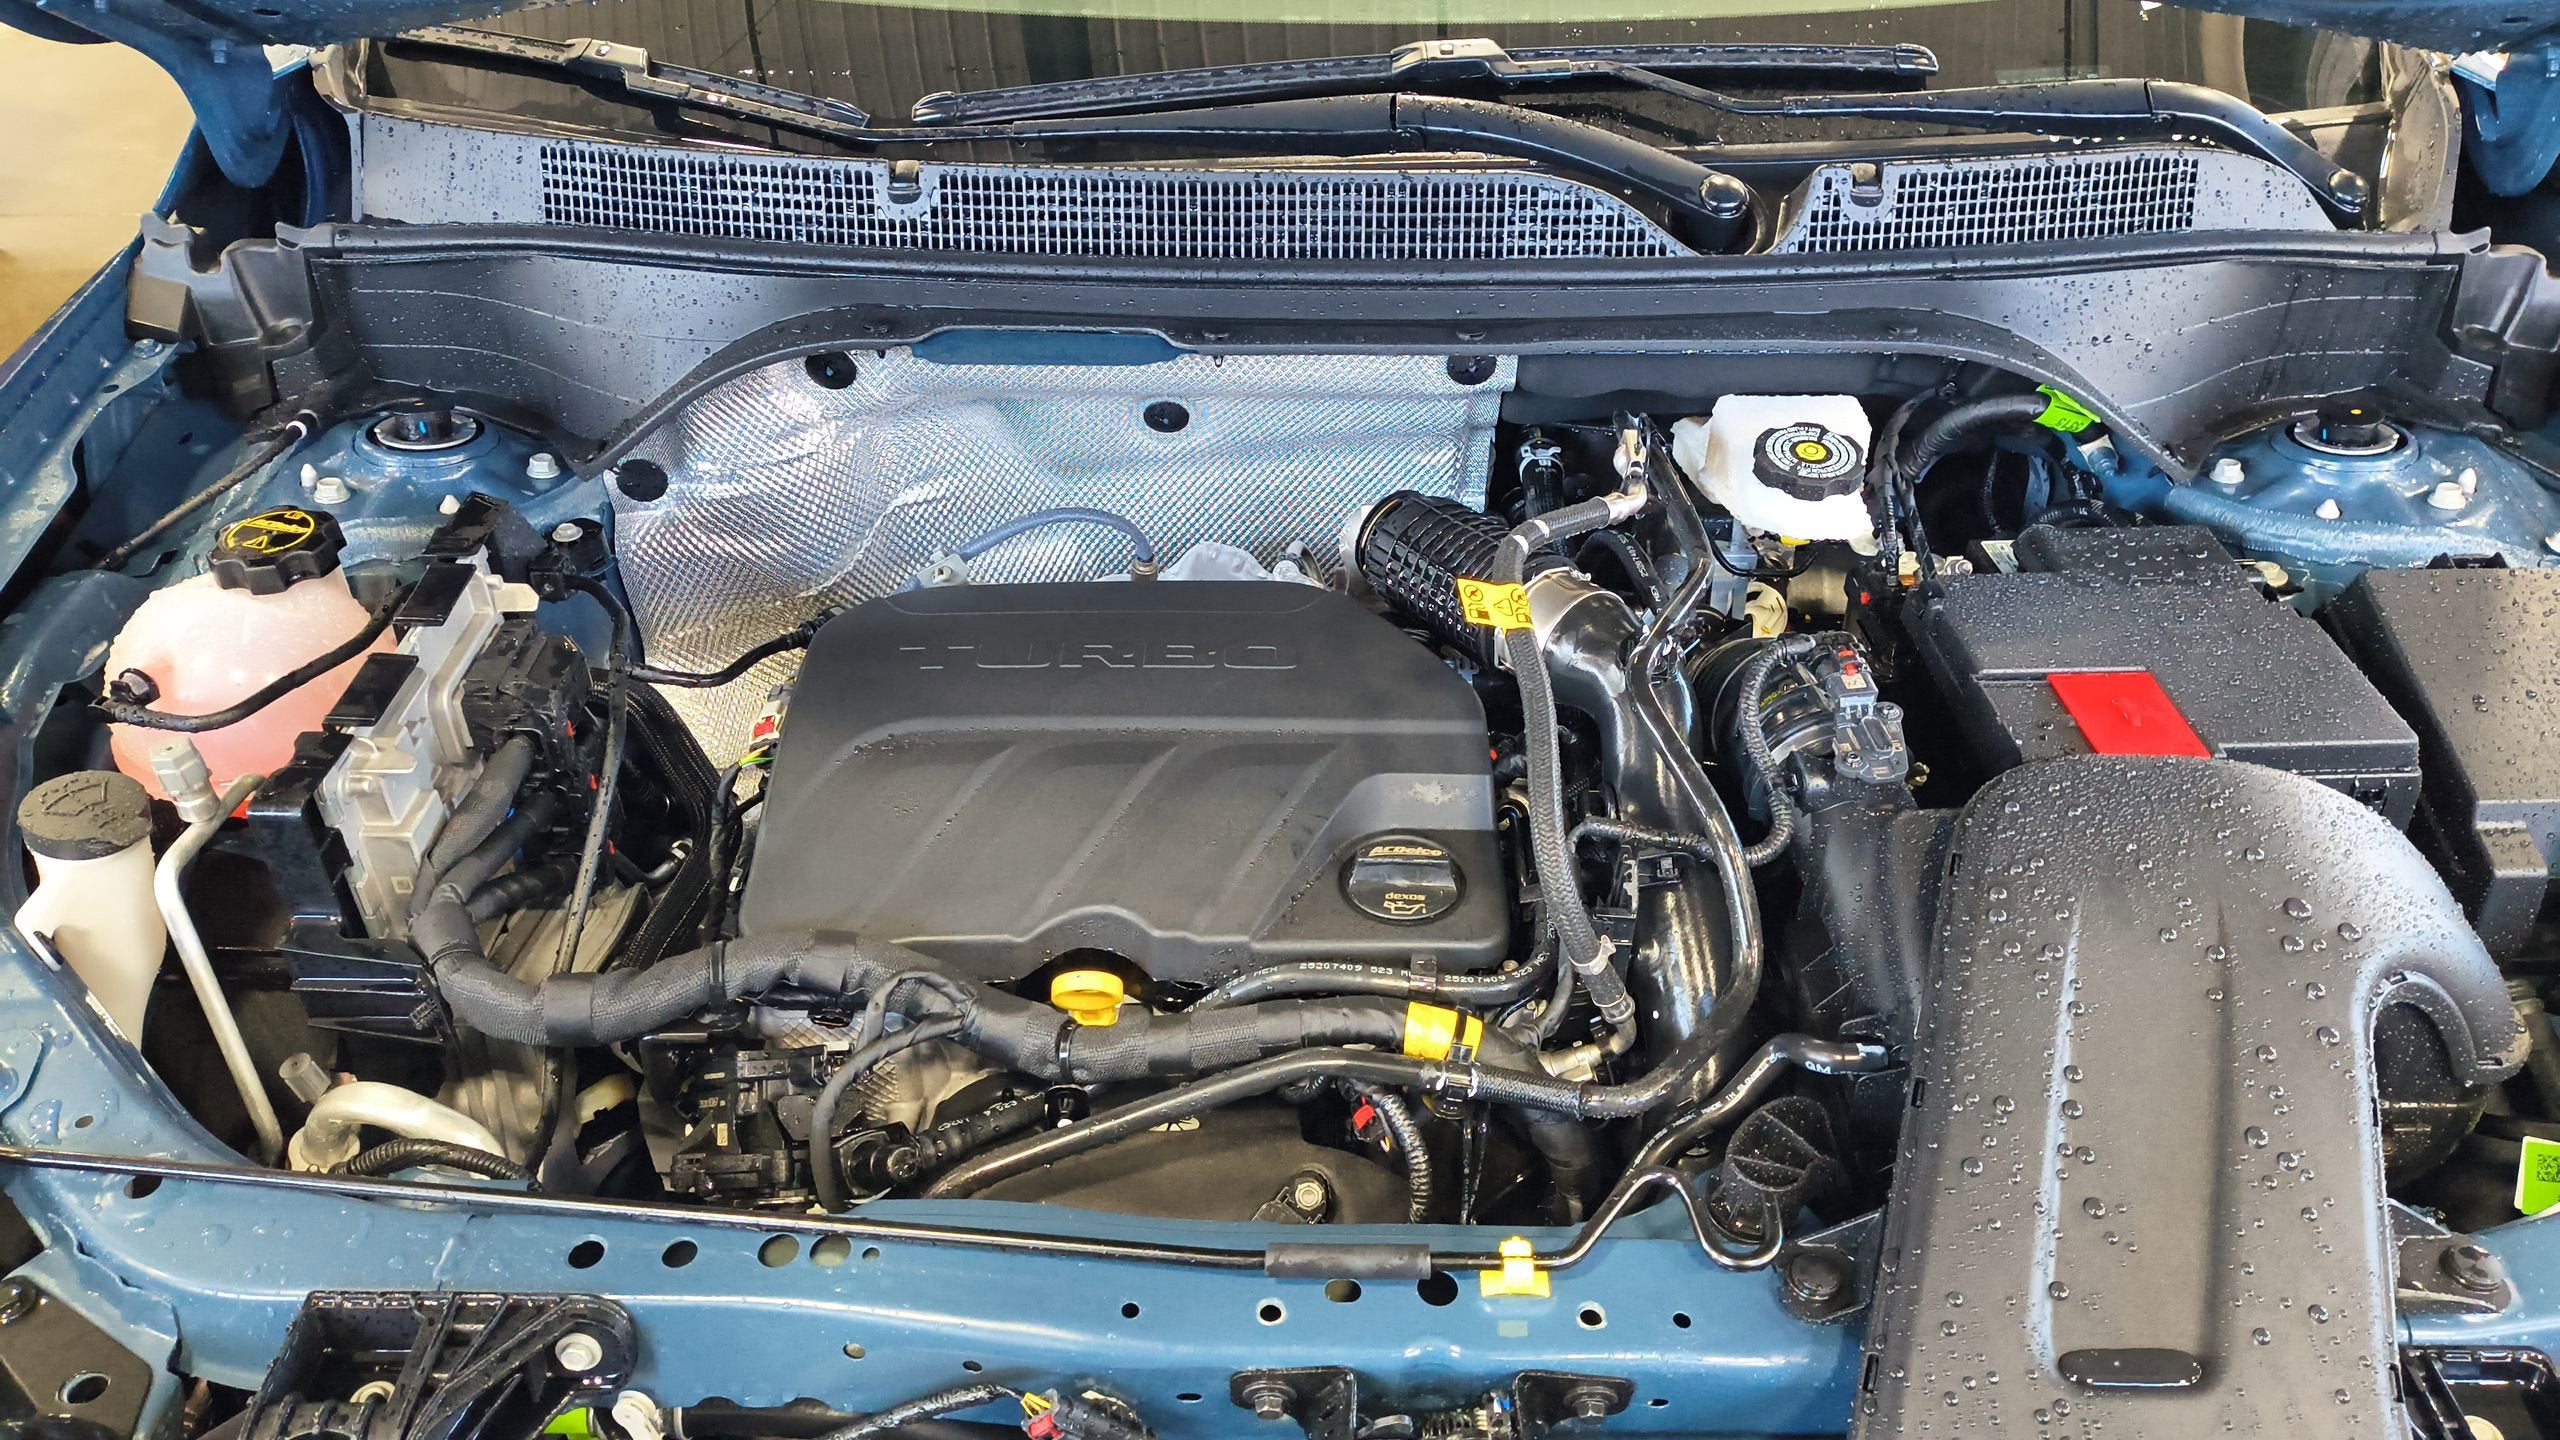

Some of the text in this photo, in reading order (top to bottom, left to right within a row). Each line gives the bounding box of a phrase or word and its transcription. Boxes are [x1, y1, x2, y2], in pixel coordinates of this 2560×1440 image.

[899, 644, 1297, 669] TURBO
[1368, 846, 1443, 857] ACDelco
[1385, 892, 1426, 901] dexos
[1299, 962, 1363, 972] 25207409
[1370, 966, 1394, 975] 523
[1511, 966, 1533, 979] 523
